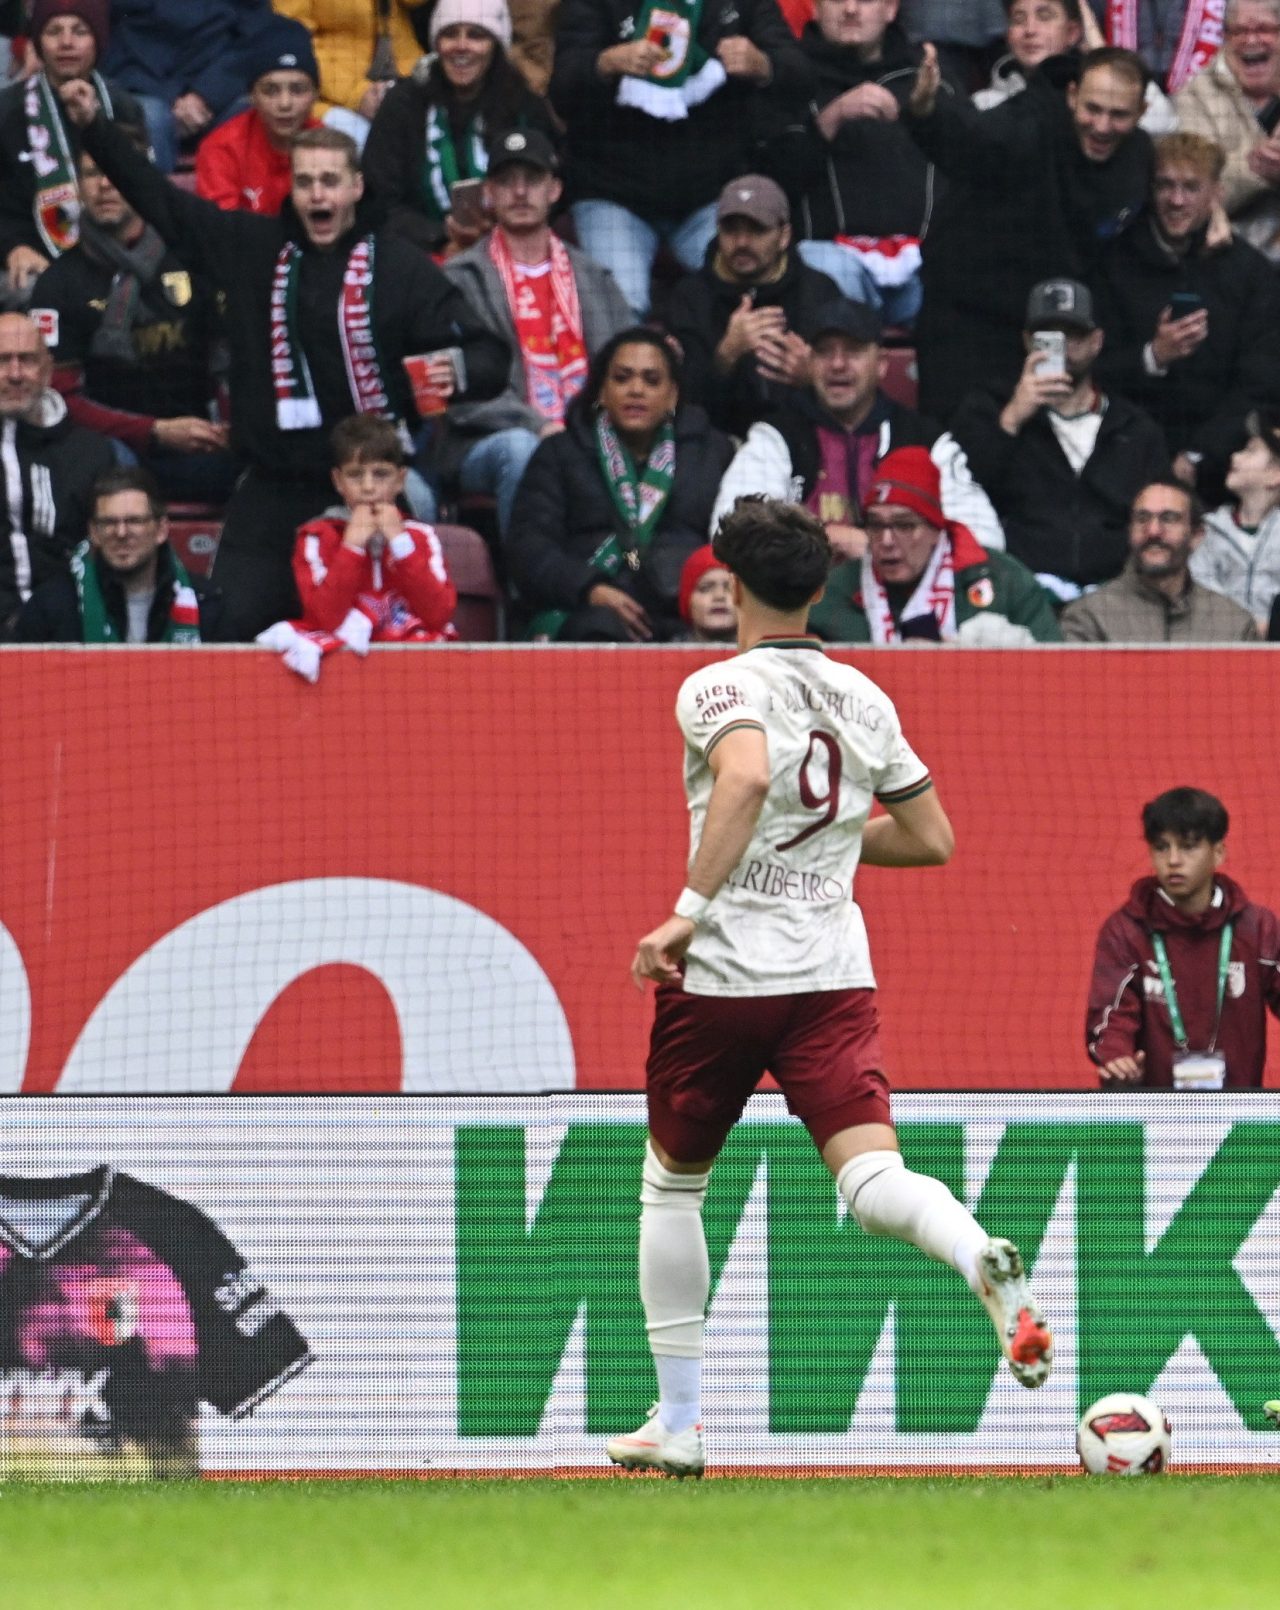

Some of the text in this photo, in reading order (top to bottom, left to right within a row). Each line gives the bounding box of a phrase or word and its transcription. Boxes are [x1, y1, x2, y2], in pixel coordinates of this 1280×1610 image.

[701, 692, 746, 726] mun
[776, 729, 842, 853] 9
[740, 859, 844, 901] RIBEIRO
